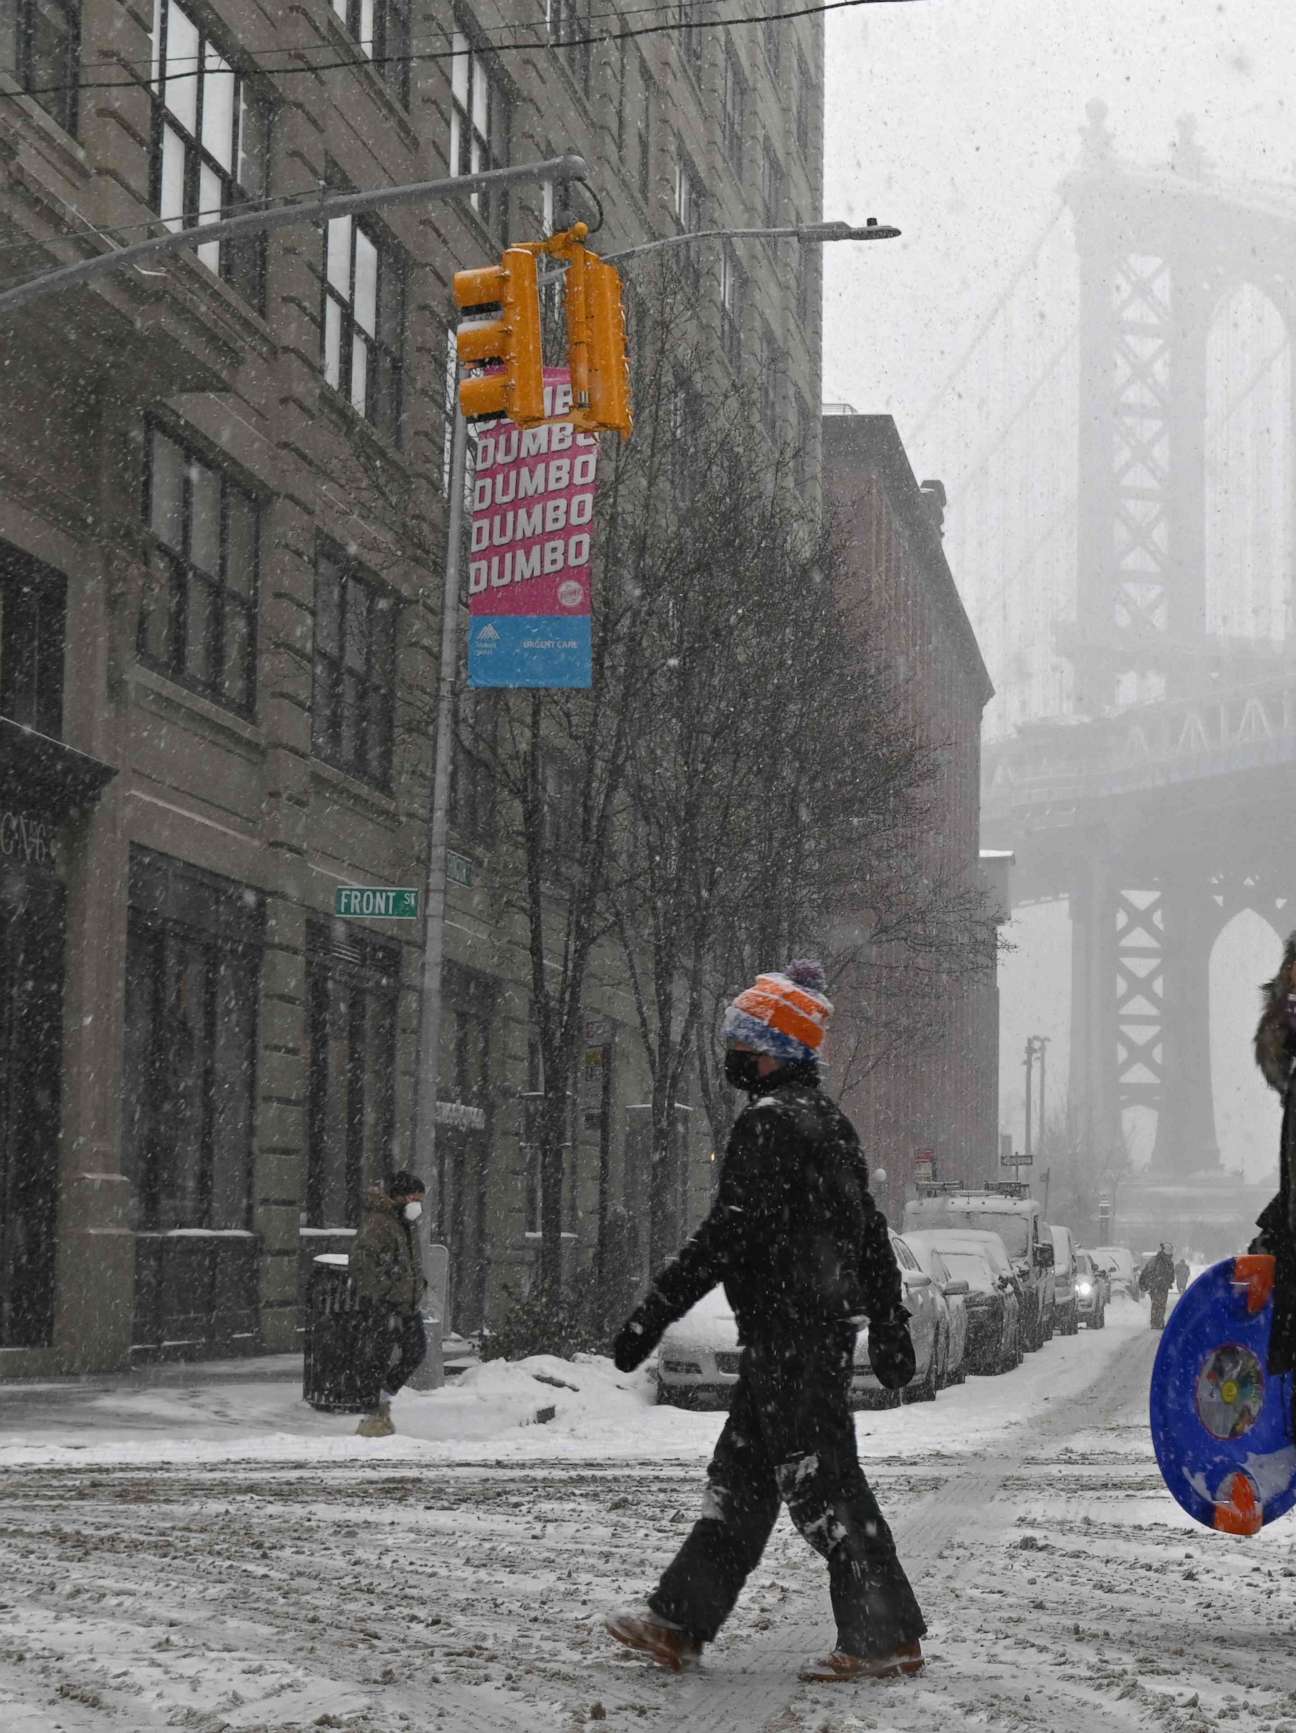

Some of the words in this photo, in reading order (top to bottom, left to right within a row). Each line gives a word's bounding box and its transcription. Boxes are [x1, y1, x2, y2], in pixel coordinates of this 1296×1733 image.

[474, 454, 597, 512] DUMBO
[471, 493, 593, 553] DUMBO
[469, 533, 591, 594] DUMBO
[523, 640, 556, 650] URGENT
[340, 890, 396, 914] FRONT
[404, 893, 416, 906] ST
